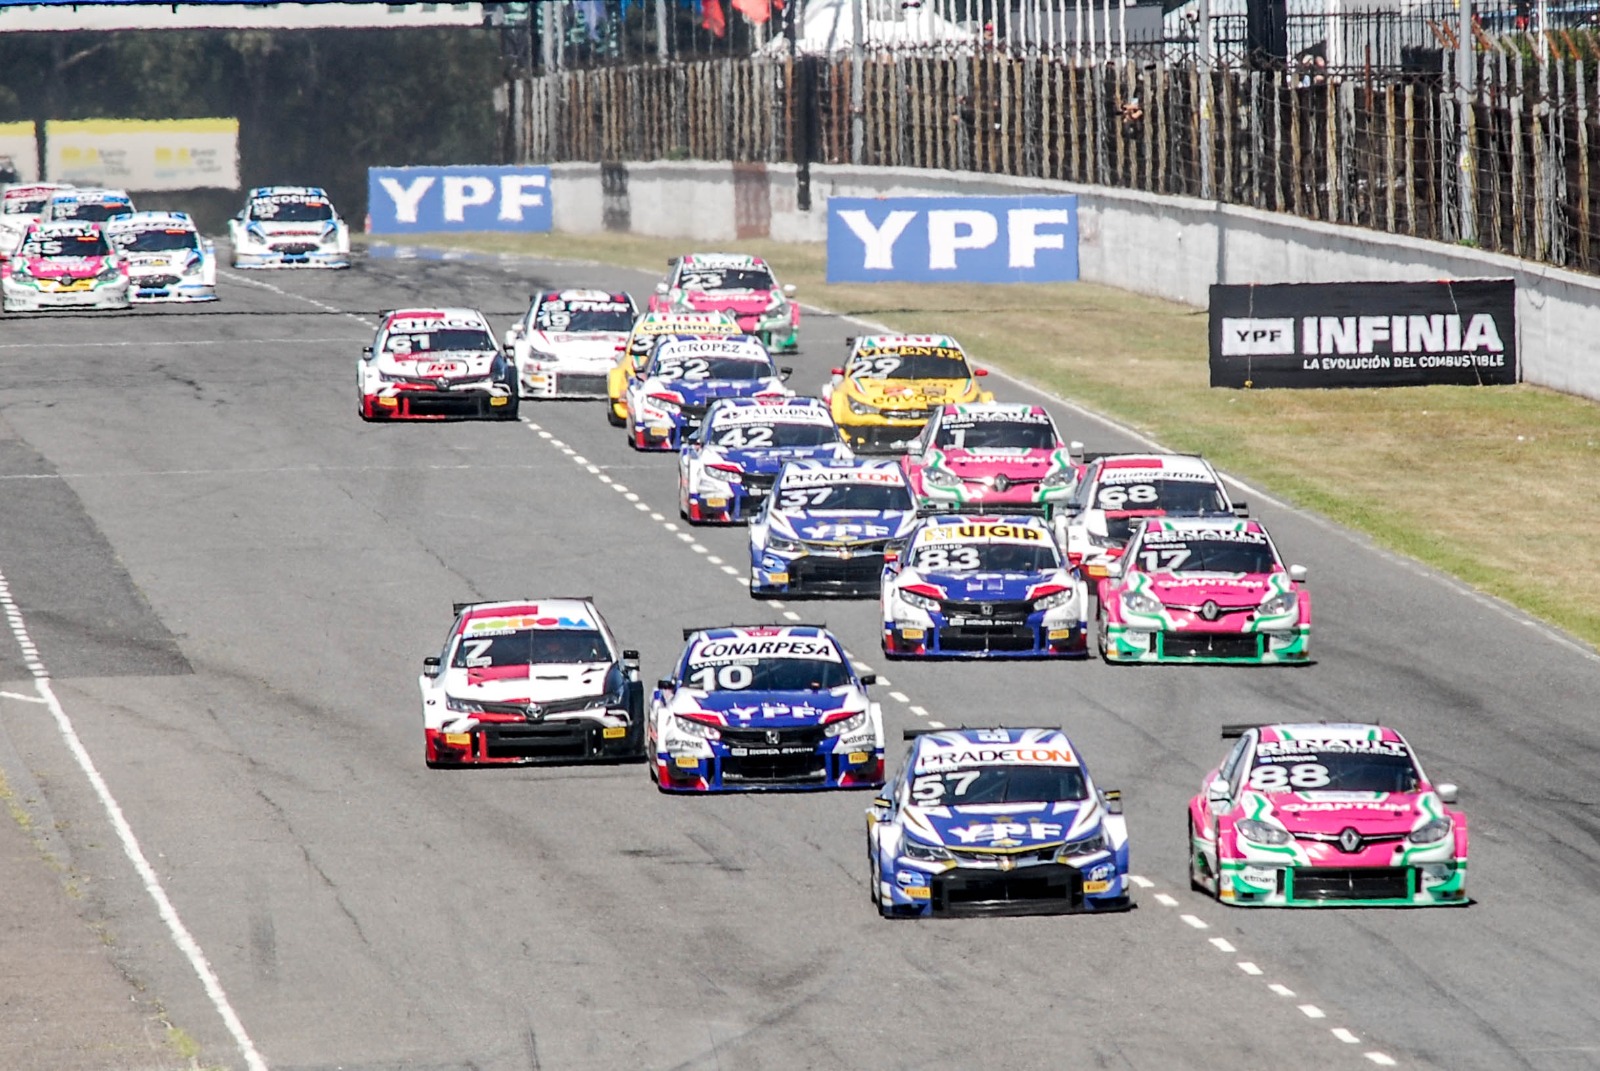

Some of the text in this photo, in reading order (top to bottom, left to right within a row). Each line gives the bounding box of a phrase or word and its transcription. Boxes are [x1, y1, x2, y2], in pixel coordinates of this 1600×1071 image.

[379, 174, 546, 223] YPF
[836, 208, 1068, 269] YPF
[682, 273, 722, 289] 23
[393, 319, 482, 329] CHACO
[1303, 313, 1504, 354] INFINIA
[387, 334, 430, 354] 61
[1237, 329, 1282, 343] YPF
[666, 343, 740, 355] AGROPEZ
[858, 345, 963, 360] VICENTE
[659, 359, 711, 380] 52
[850, 357, 901, 379] 29
[1303, 354, 1505, 370] LA EVOLUCIÓN DEL COMBUSTIBLE
[744, 405, 824, 418] PATAGONIA
[718, 427, 774, 448] 42
[944, 429, 966, 449] 1
[786, 472, 899, 484] PRADECON
[780, 487, 834, 506] 37
[1098, 484, 1158, 503] 68
[802, 524, 890, 539] YPF
[959, 525, 1040, 540] VIGIA
[917, 548, 981, 570] 83
[1139, 549, 1192, 571] 17
[700, 641, 831, 658] CONARPESA
[690, 665, 753, 691] 10
[728, 705, 817, 720] YPF
[921, 749, 1072, 766] PRADECON
[912, 770, 981, 800] 57
[1250, 763, 1331, 790] 88
[1280, 802, 1411, 811] QUANTIUM
[948, 823, 1063, 843] YPF
